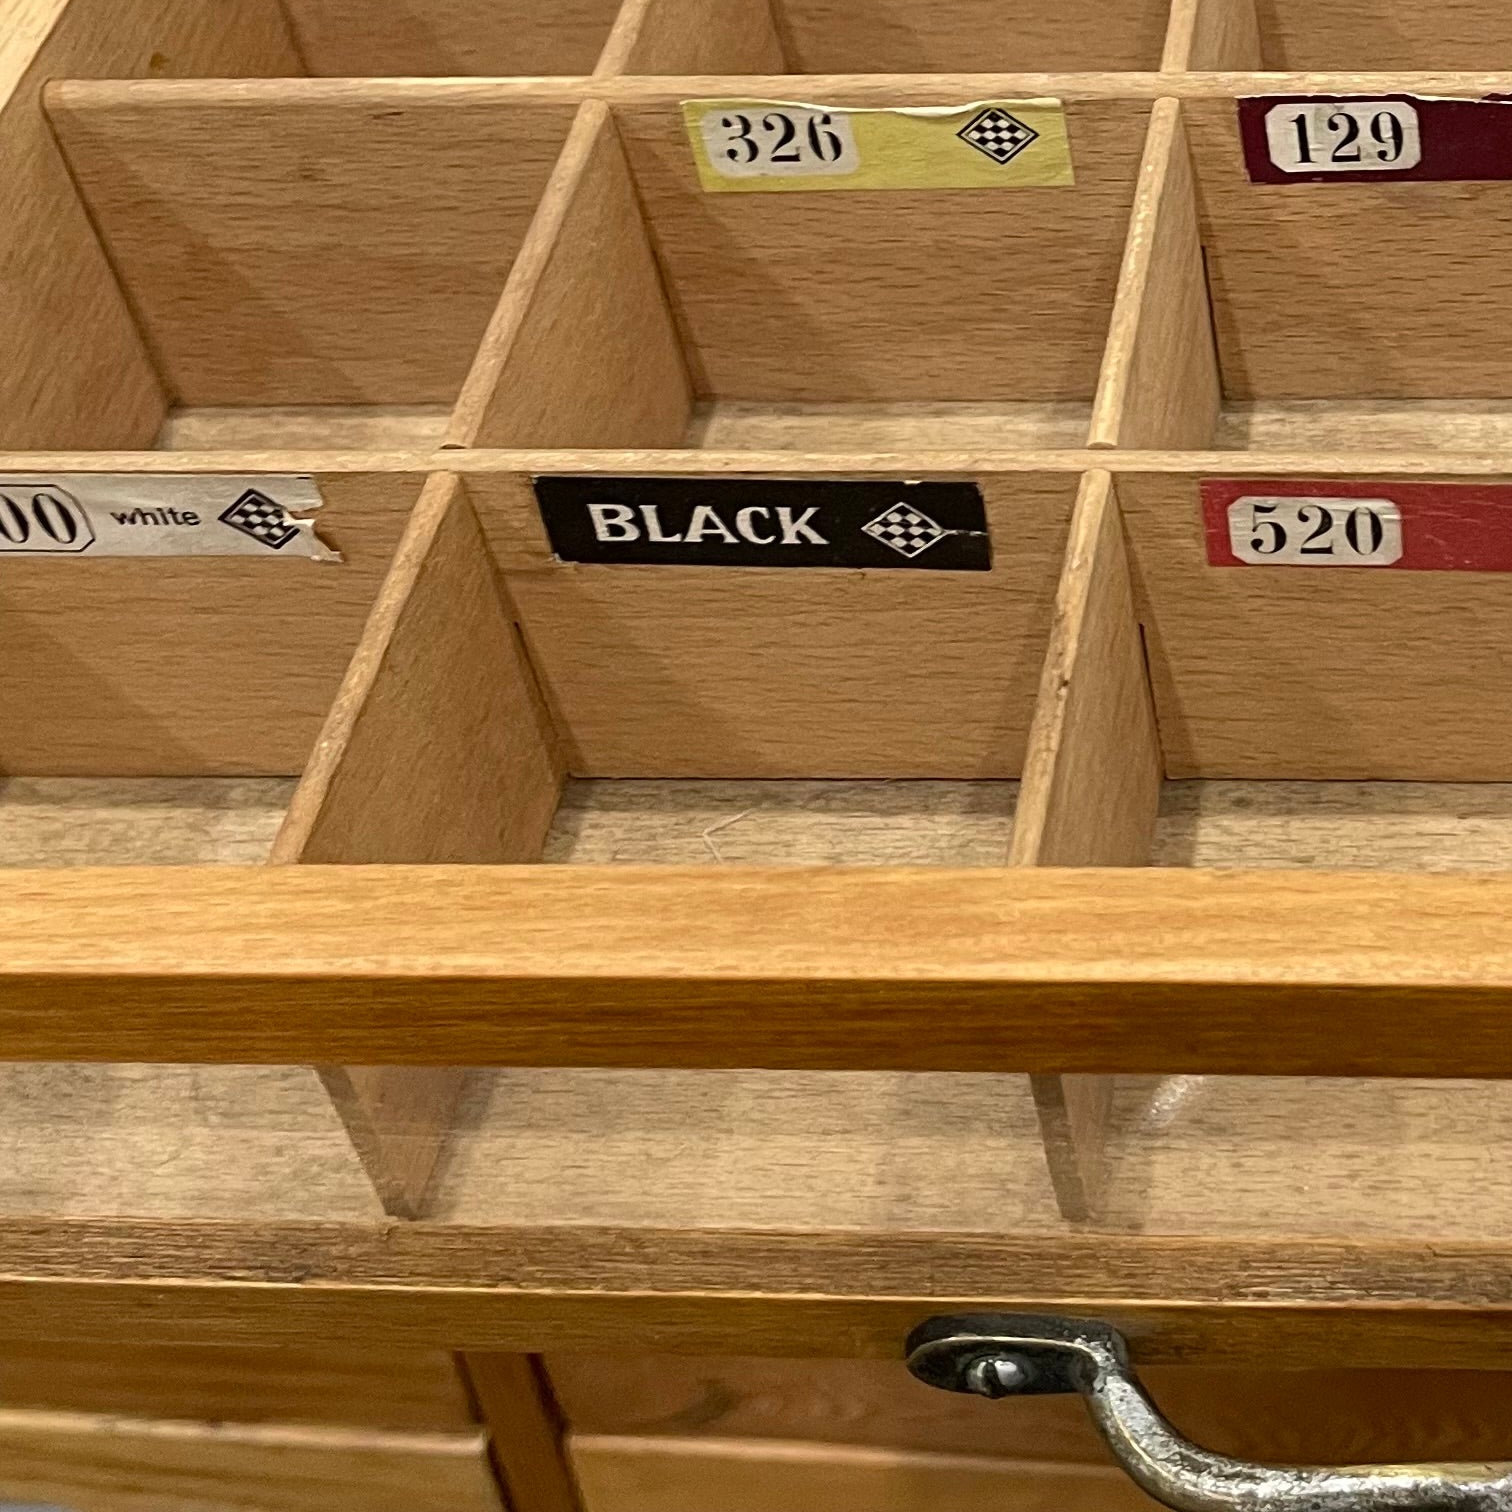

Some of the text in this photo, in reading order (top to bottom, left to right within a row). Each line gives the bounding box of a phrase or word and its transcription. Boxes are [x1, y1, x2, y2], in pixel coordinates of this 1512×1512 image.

[721, 113, 843, 164] 326
[1290, 111, 1404, 164] 129
[110, 506, 201, 527] white
[586, 503, 829, 545] BLACK
[1250, 504, 1383, 555] 520
